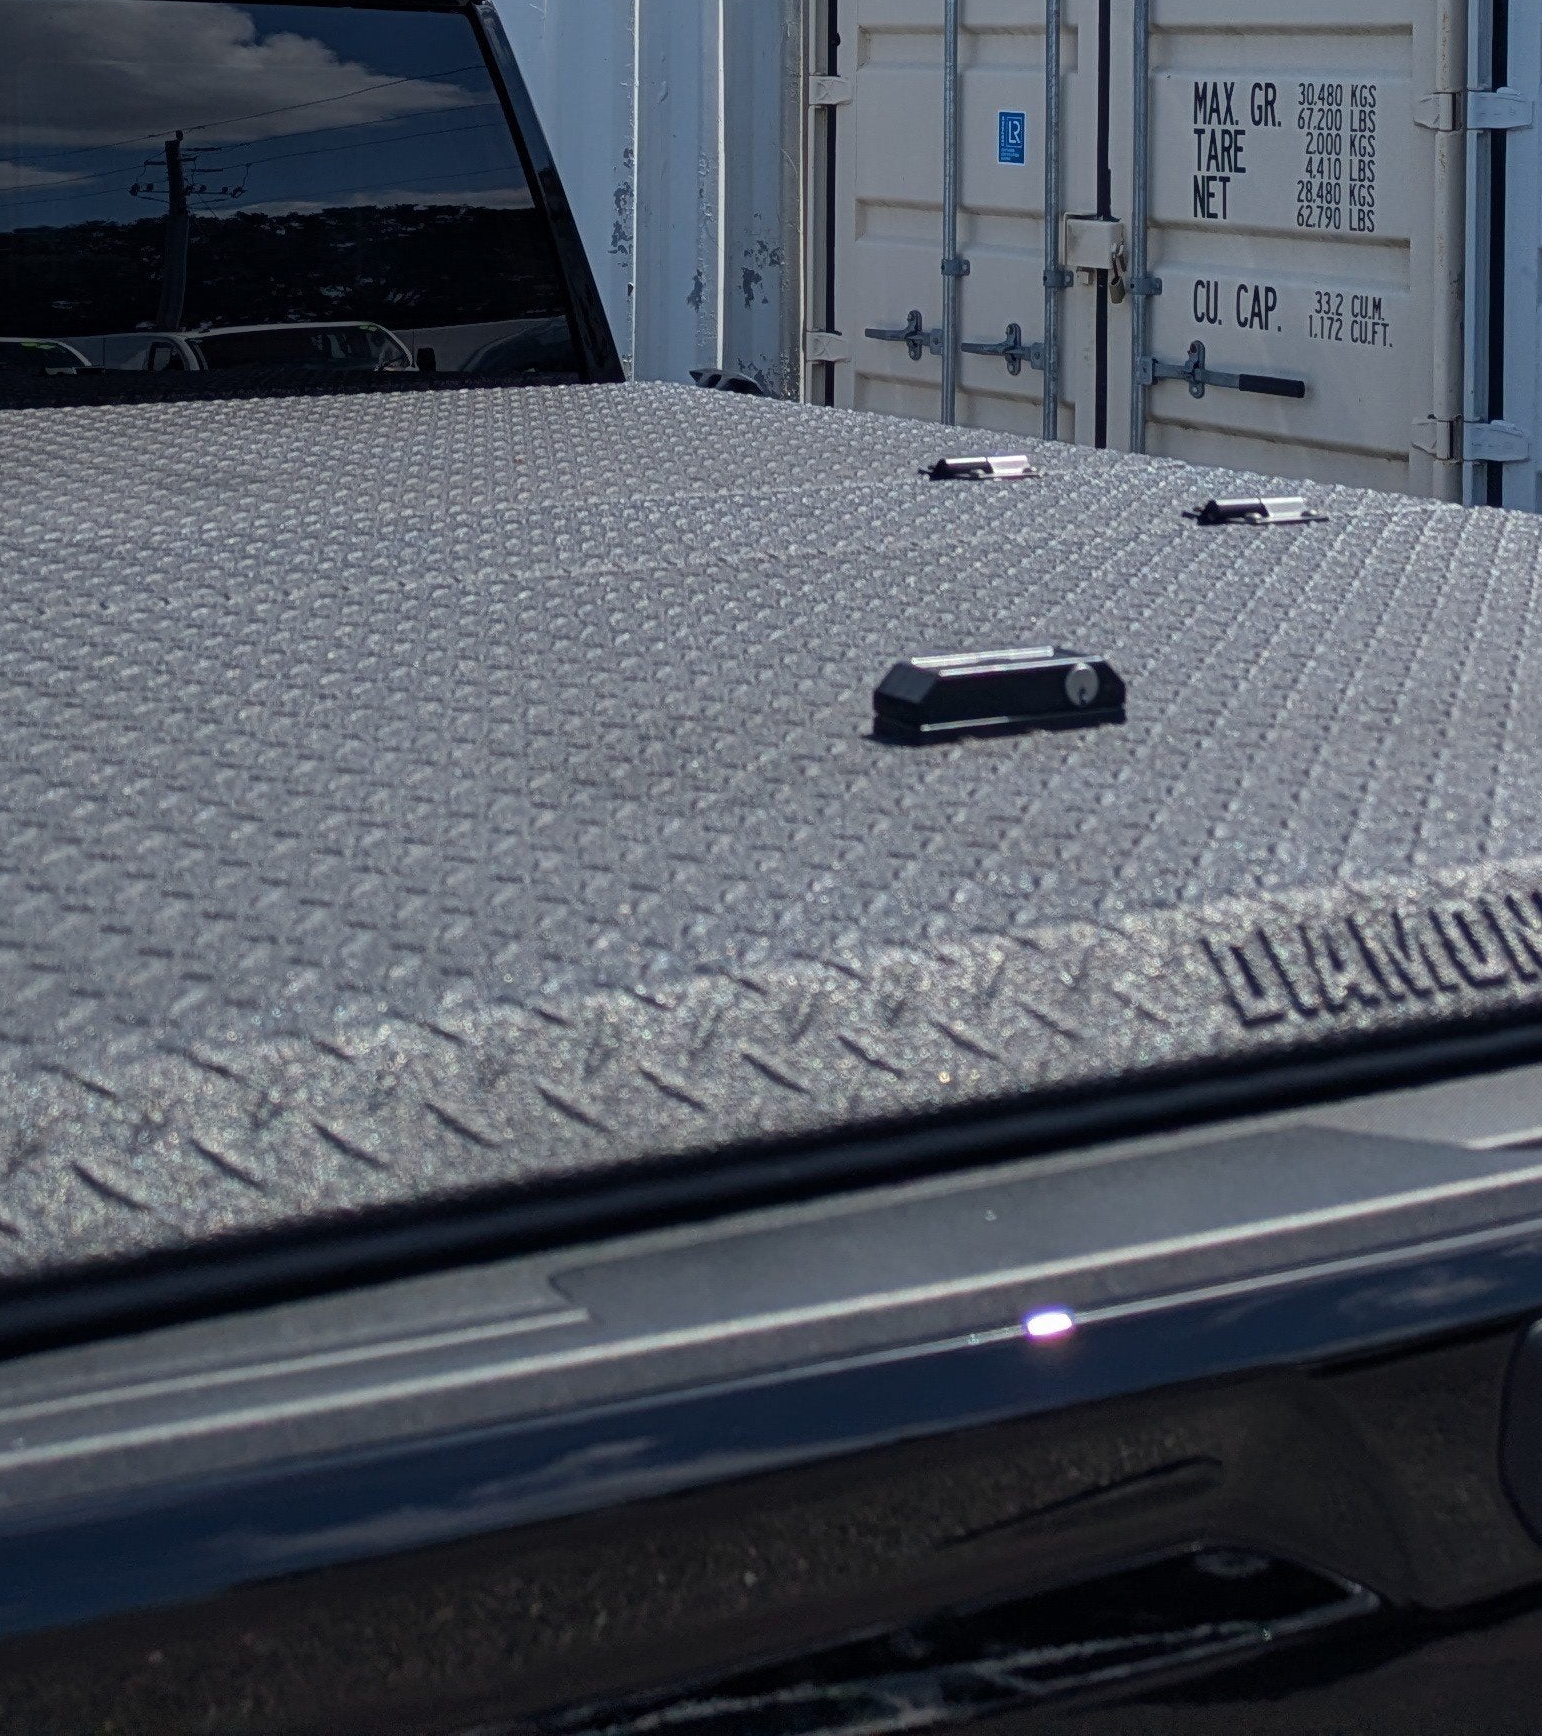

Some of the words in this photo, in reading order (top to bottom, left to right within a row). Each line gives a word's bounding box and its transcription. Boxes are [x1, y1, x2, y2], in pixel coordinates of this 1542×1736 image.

[1194, 82, 1238, 125] MAX.
[1251, 83, 1281, 127] GR.
[1351, 85, 1376, 108] KGS
[1350, 110, 1375, 133] LBS
[1194, 128, 1246, 173] TARE
[1350, 135, 1375, 157] KGS
[1350, 159, 1375, 182] LBS
[1194, 175, 1230, 219] NET
[1349, 184, 1374, 207] KGS
[1349, 208, 1374, 232] LBS
[1194, 280, 1222, 325] CU.
[1237, 284, 1281, 331] CAP.
[1315, 291, 1343, 317] 33.2
